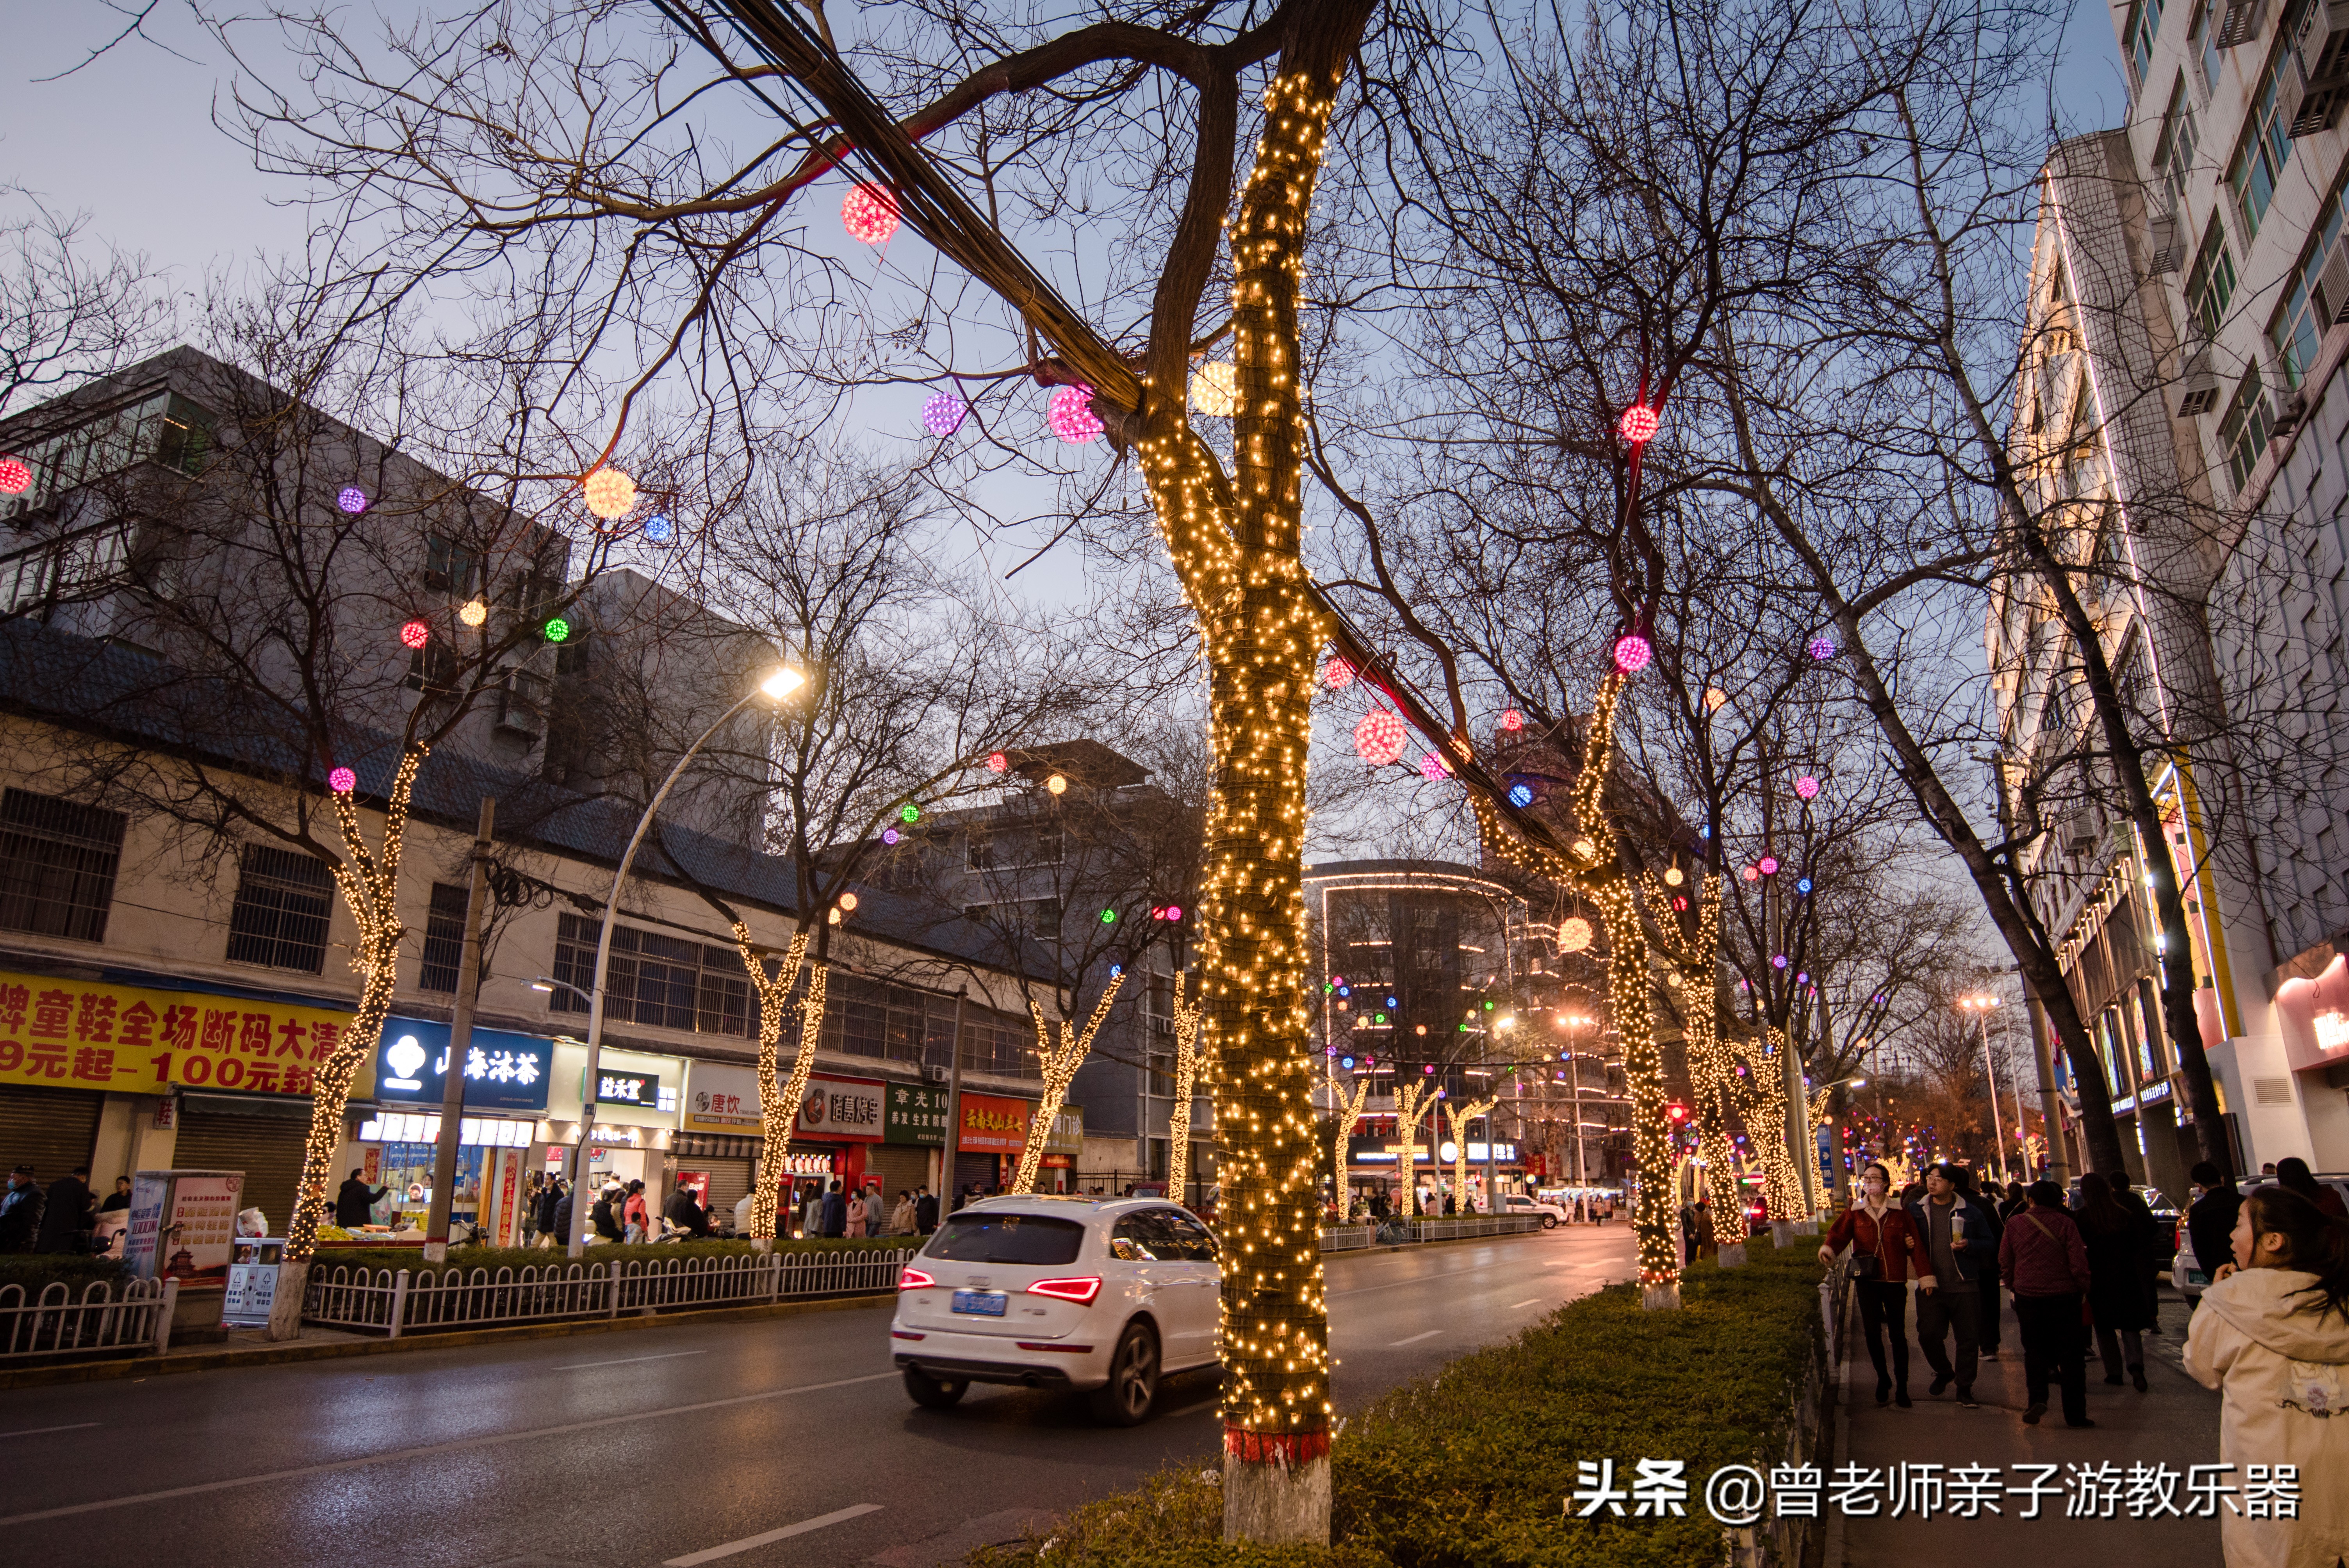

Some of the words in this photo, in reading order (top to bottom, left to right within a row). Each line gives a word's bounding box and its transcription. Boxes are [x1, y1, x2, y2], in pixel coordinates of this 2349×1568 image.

[0, 983, 366, 1067] 牌童鞋全场断码大清
[435, 1046, 540, 1085] 山海沐茶
[599, 1076, 642, 1099] 益禾堂
[157, 1099, 172, 1125] 鞋
[711, 1094, 740, 1115] 唐饮
[831, 1094, 879, 1124] 诸葛烤串
[966, 1108, 1024, 1131] 云南文山三七
[1049, 1113, 1081, 1135] 康门诊
[132, 1220, 158, 1235] 1000M
